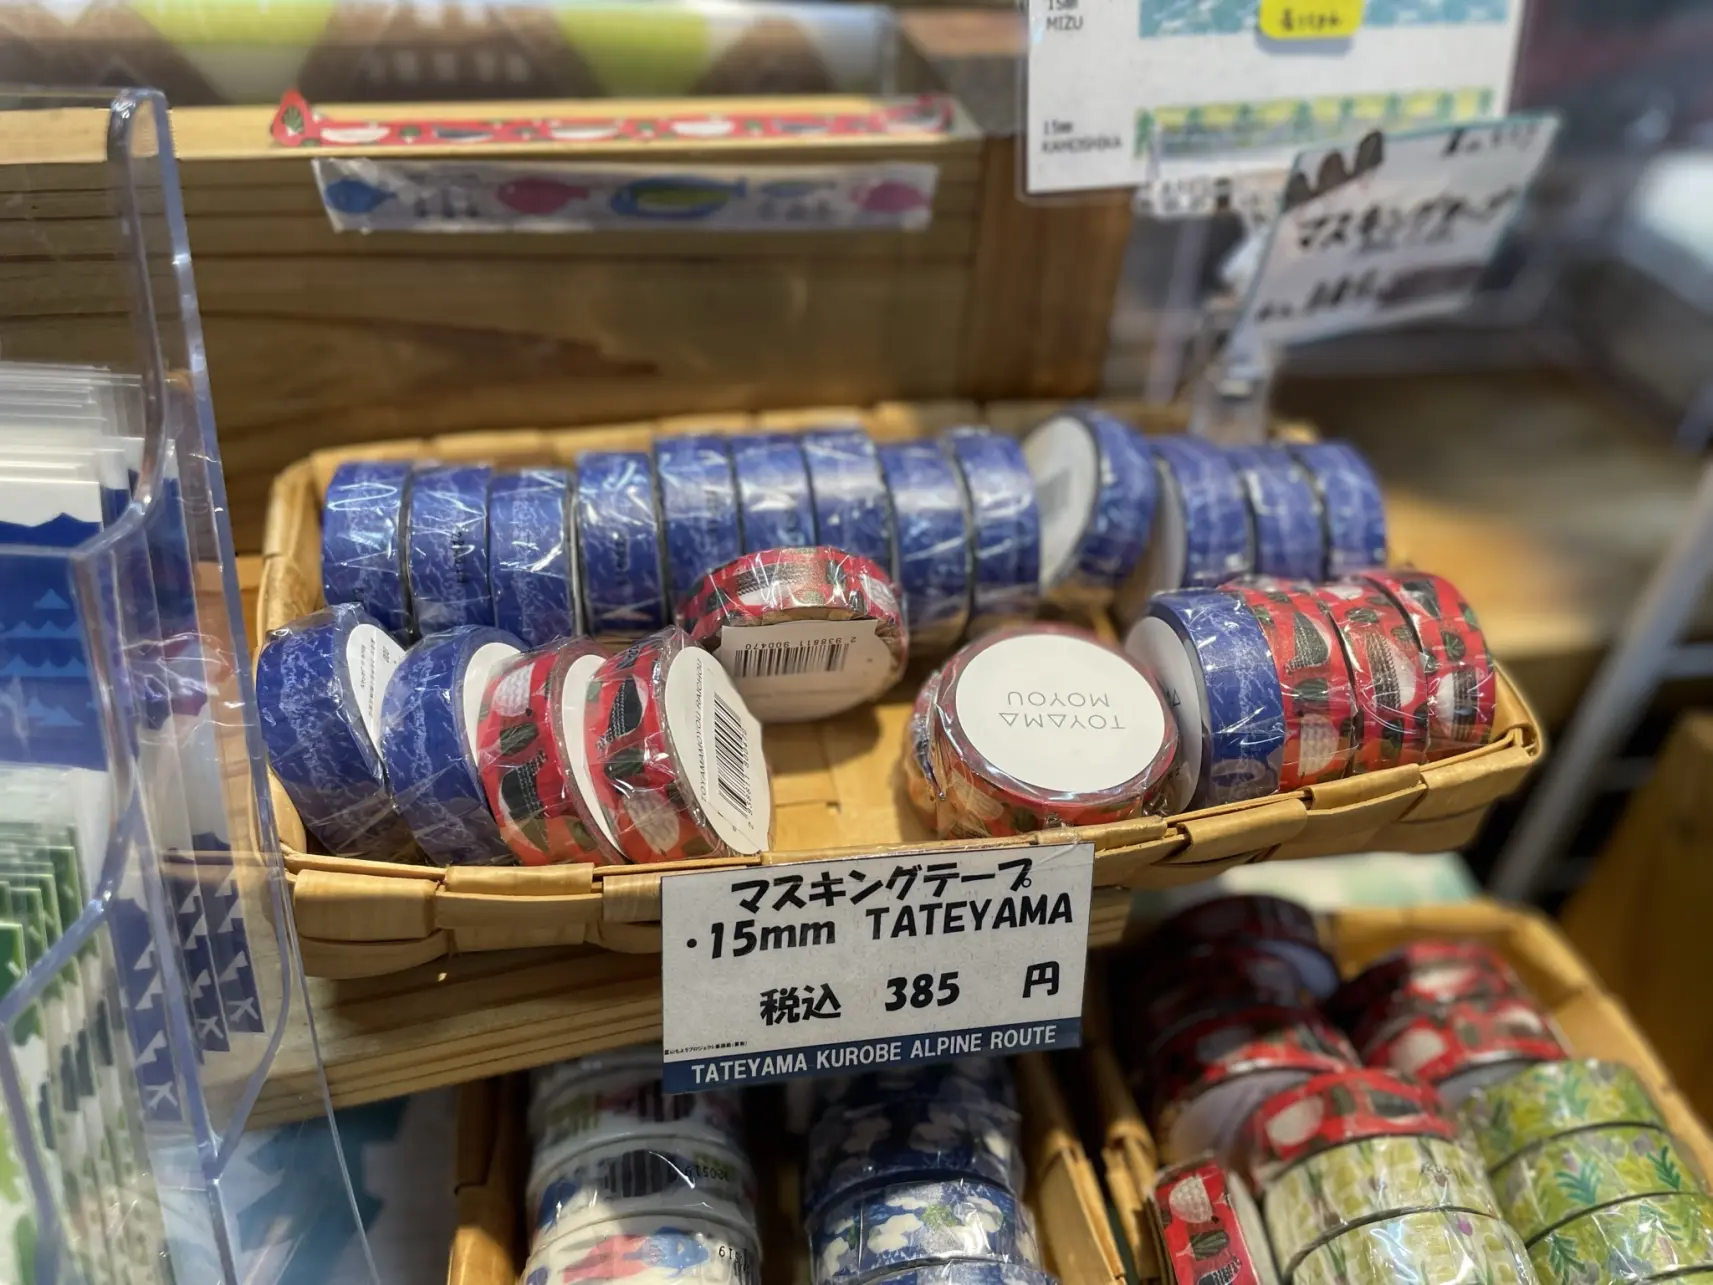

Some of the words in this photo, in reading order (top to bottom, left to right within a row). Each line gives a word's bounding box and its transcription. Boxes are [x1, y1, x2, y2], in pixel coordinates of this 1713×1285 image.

[1046, 15, 1084, 31] MIZU
[745, 641, 790, 650] 900470
[1007, 691, 1110, 708] MOYOU
[998, 712, 1125, 730] TOYAMA
[731, 857, 1033, 914] マスキングテープ
[865, 892, 1073, 941] TATEYAMA
[759, 982, 842, 1027] 税込
[884, 970, 960, 1012] 385
[1022, 960, 1060, 999] 円
[691, 1048, 808, 1085] TATEYAMA
[816, 1040, 902, 1071] KUROBE
[909, 1032, 982, 1060] ALPINE
[989, 1024, 1057, 1051] ROUTE
